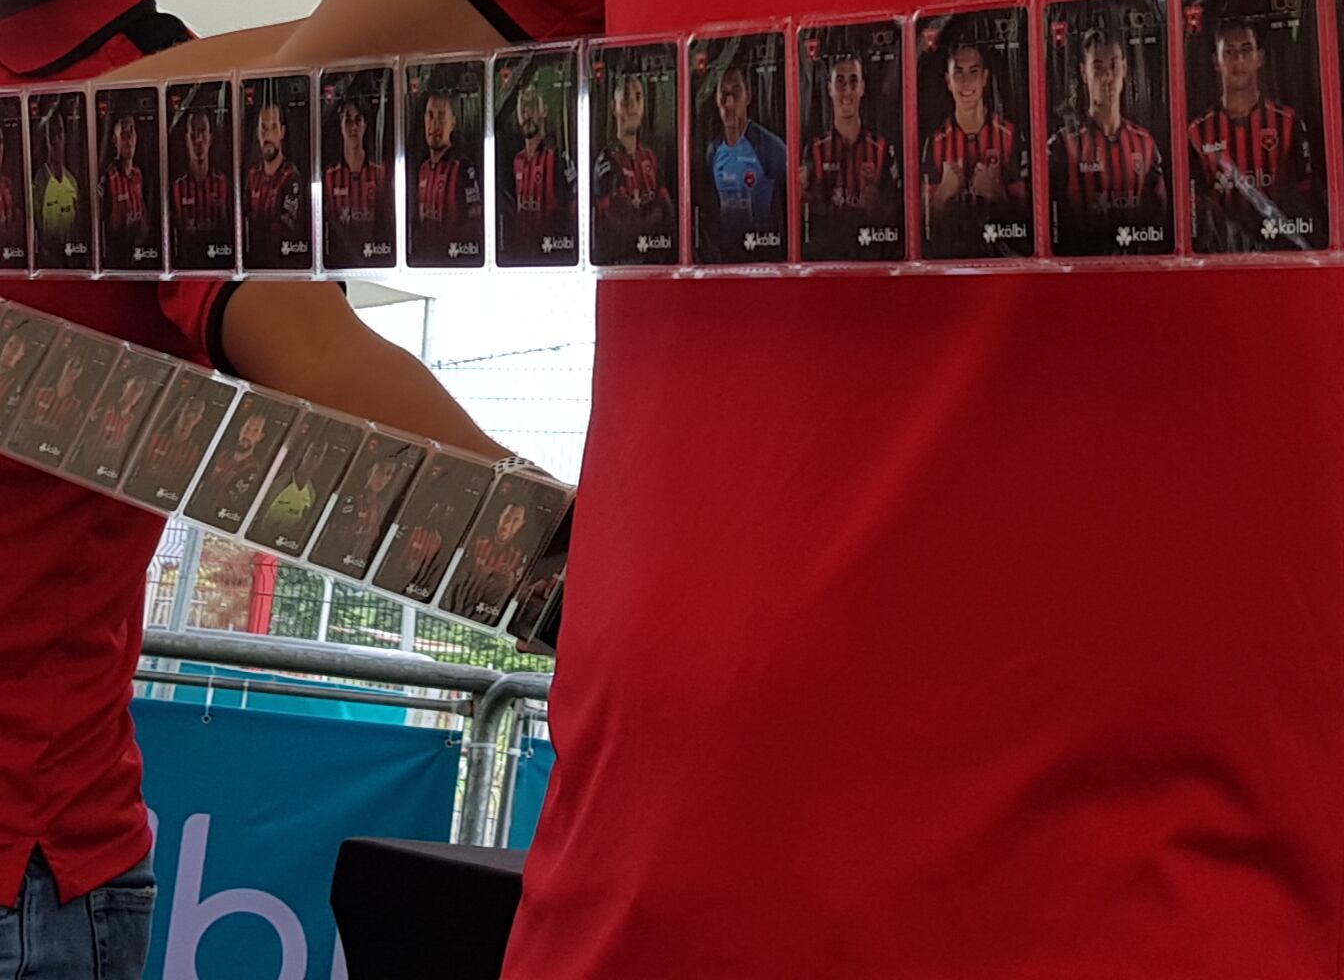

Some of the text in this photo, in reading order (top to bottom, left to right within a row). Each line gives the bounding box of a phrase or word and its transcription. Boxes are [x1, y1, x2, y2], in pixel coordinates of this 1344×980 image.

[996, 222, 1026, 239] kölbi
[1130, 225, 1164, 243] kölbi
[1277, 218, 1314, 235] kölbi
